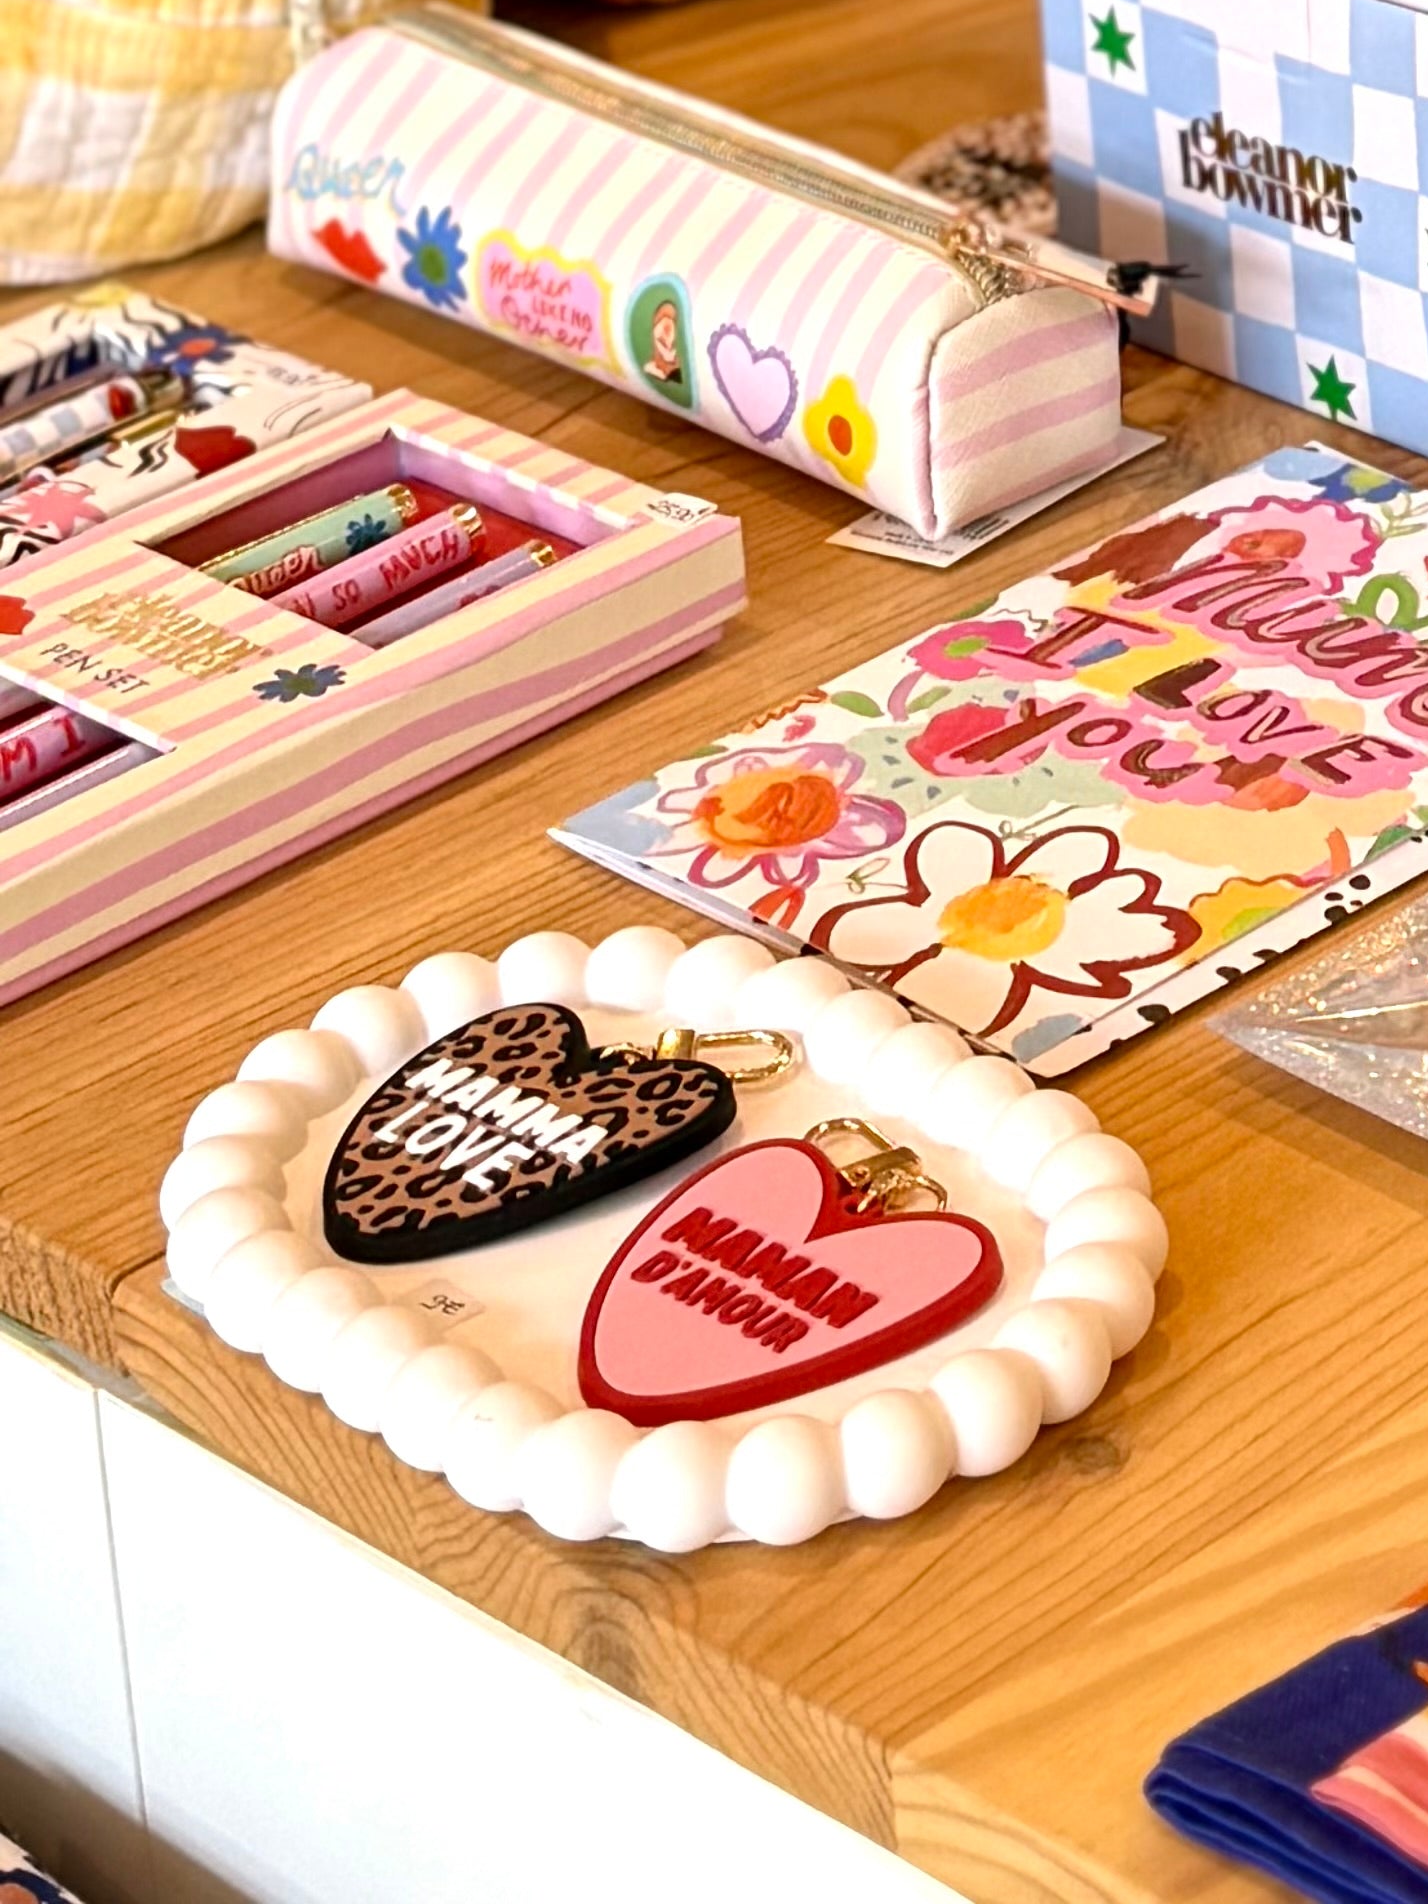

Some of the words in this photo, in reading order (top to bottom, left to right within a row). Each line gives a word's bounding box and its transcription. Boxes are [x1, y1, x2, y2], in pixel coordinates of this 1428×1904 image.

[1178, 129, 1363, 245] bowmer
[1190, 111, 1358, 206] eleanor
[489, 256, 573, 298] Mother
[333, 578, 360, 612] SO
[378, 529, 460, 590] MUCH
[40, 642, 102, 675] PEN
[95, 667, 151, 696] SET
[372, 1100, 538, 1192] LOVE
[404, 1057, 609, 1166] MAMMA
[629, 1248, 812, 1355] D'AMOUR
[660, 1206, 881, 1330] MAMAN
